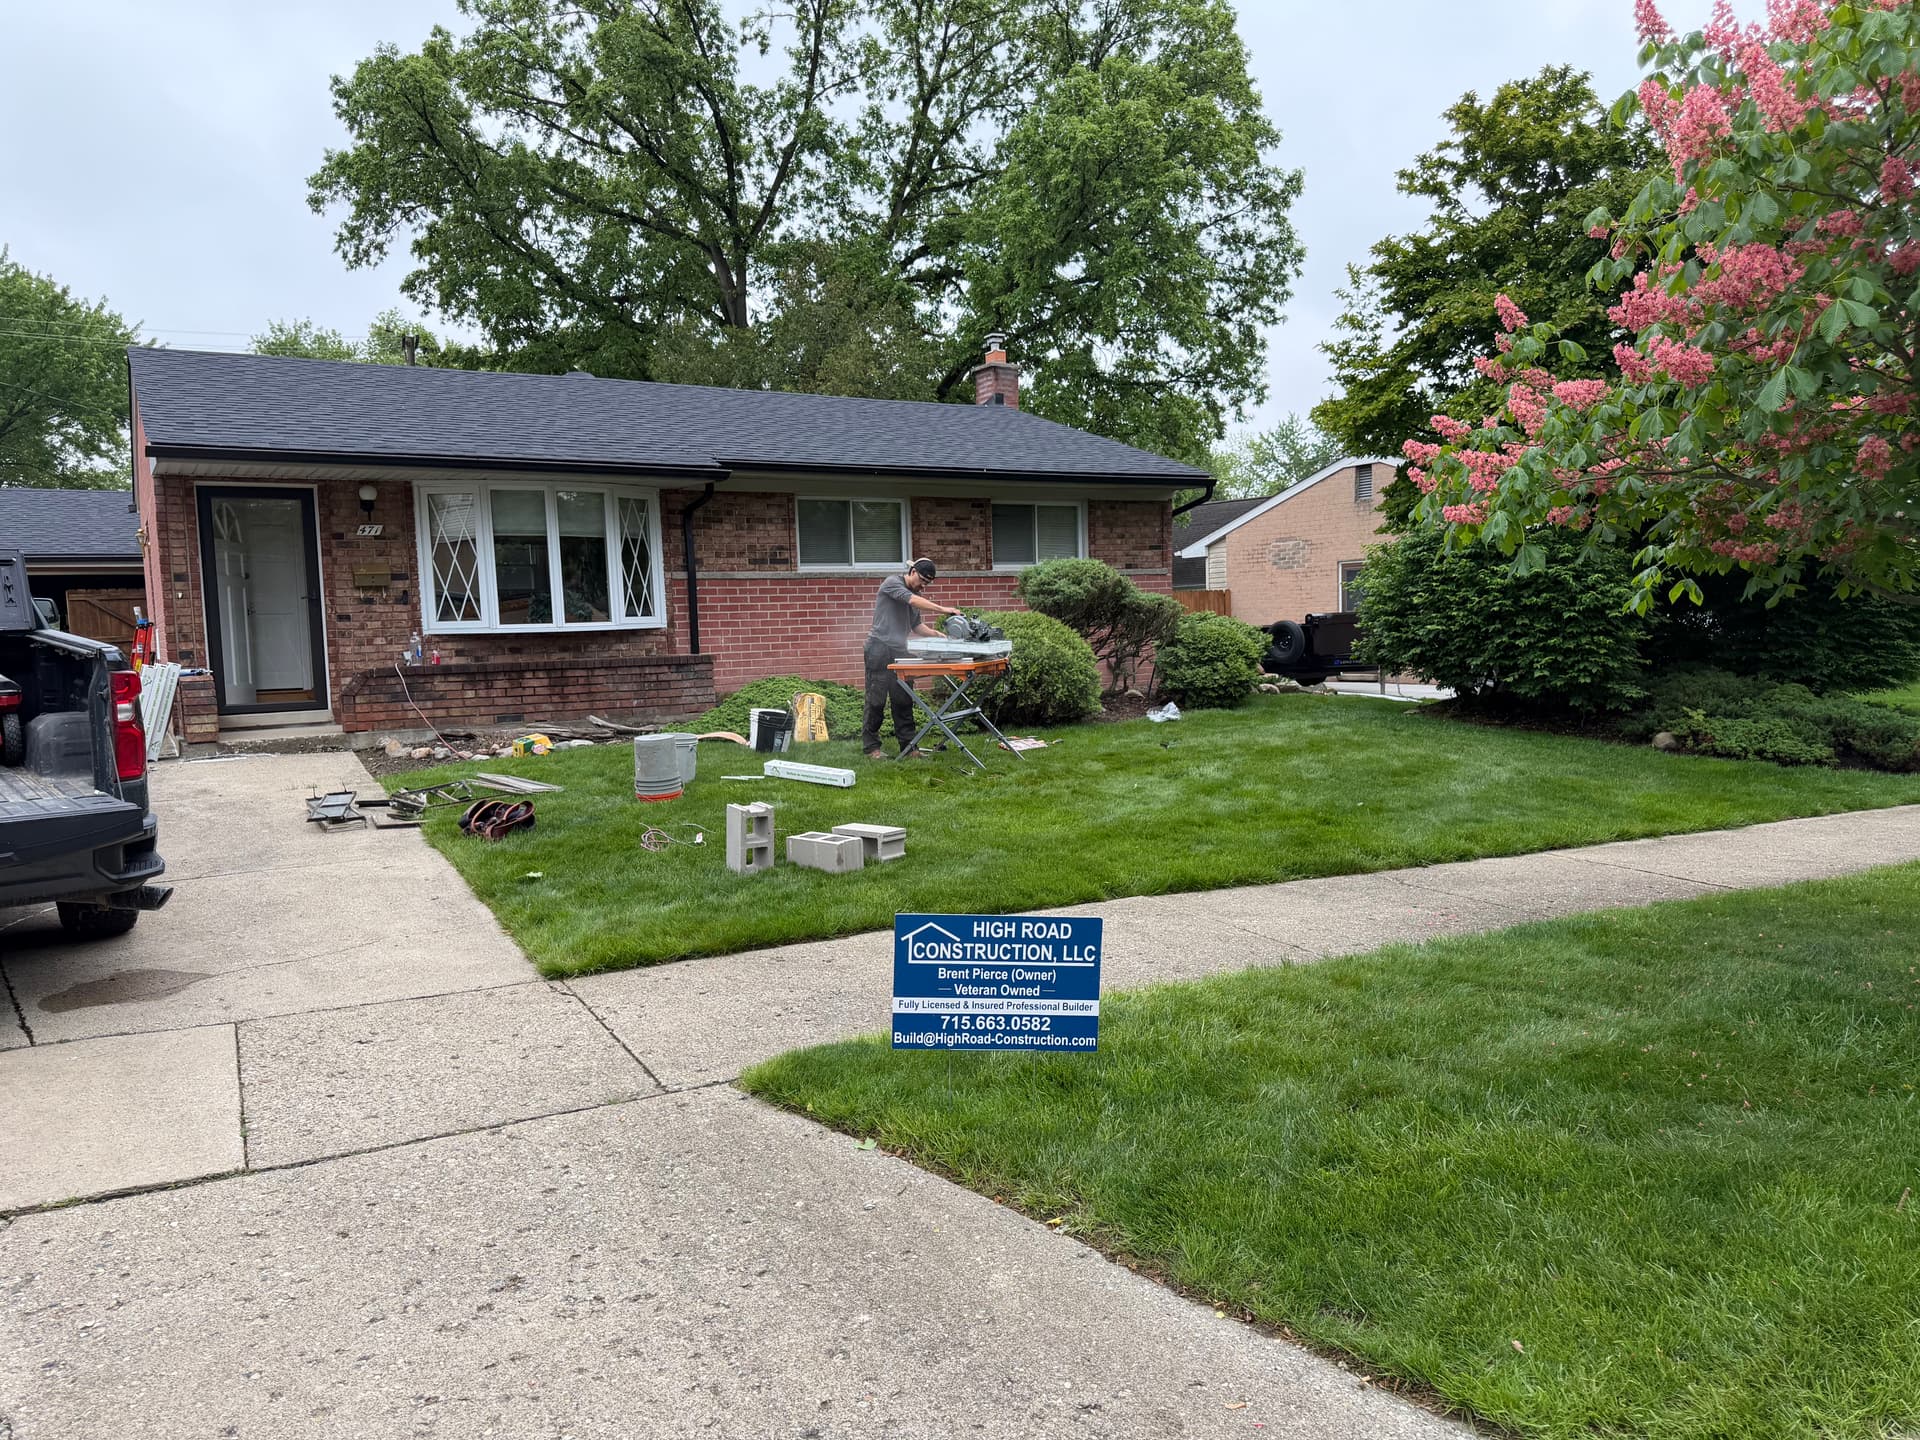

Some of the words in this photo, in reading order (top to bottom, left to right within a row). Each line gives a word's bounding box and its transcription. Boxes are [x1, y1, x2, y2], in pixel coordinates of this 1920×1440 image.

[973, 921, 1016, 938] HIGH
[1021, 922, 1073, 939] ROAD
[913, 942, 1057, 963] CONSTRUCTION,
[1063, 945, 1096, 962] LLC
[938, 968, 969, 979] Brent
[972, 968, 1008, 980] Pierce
[1011, 968, 1056, 983] (Owner)
[954, 983, 997, 996] Veteran
[1000, 984, 1040, 996] Owned
[898, 1000, 919, 1011] Fully
[922, 1000, 960, 1009] Licensed
[963, 1001, 969, 1009] &
[972, 1001, 1004, 1010] Insured
[1006, 1001, 1060, 1011] Professional
[1062, 1002, 1093, 1012] Builder
[941, 1016, 1051, 1031] 715.663.0582
[894, 1032, 1096, 1046] Build@HighRoad-Construction.com
